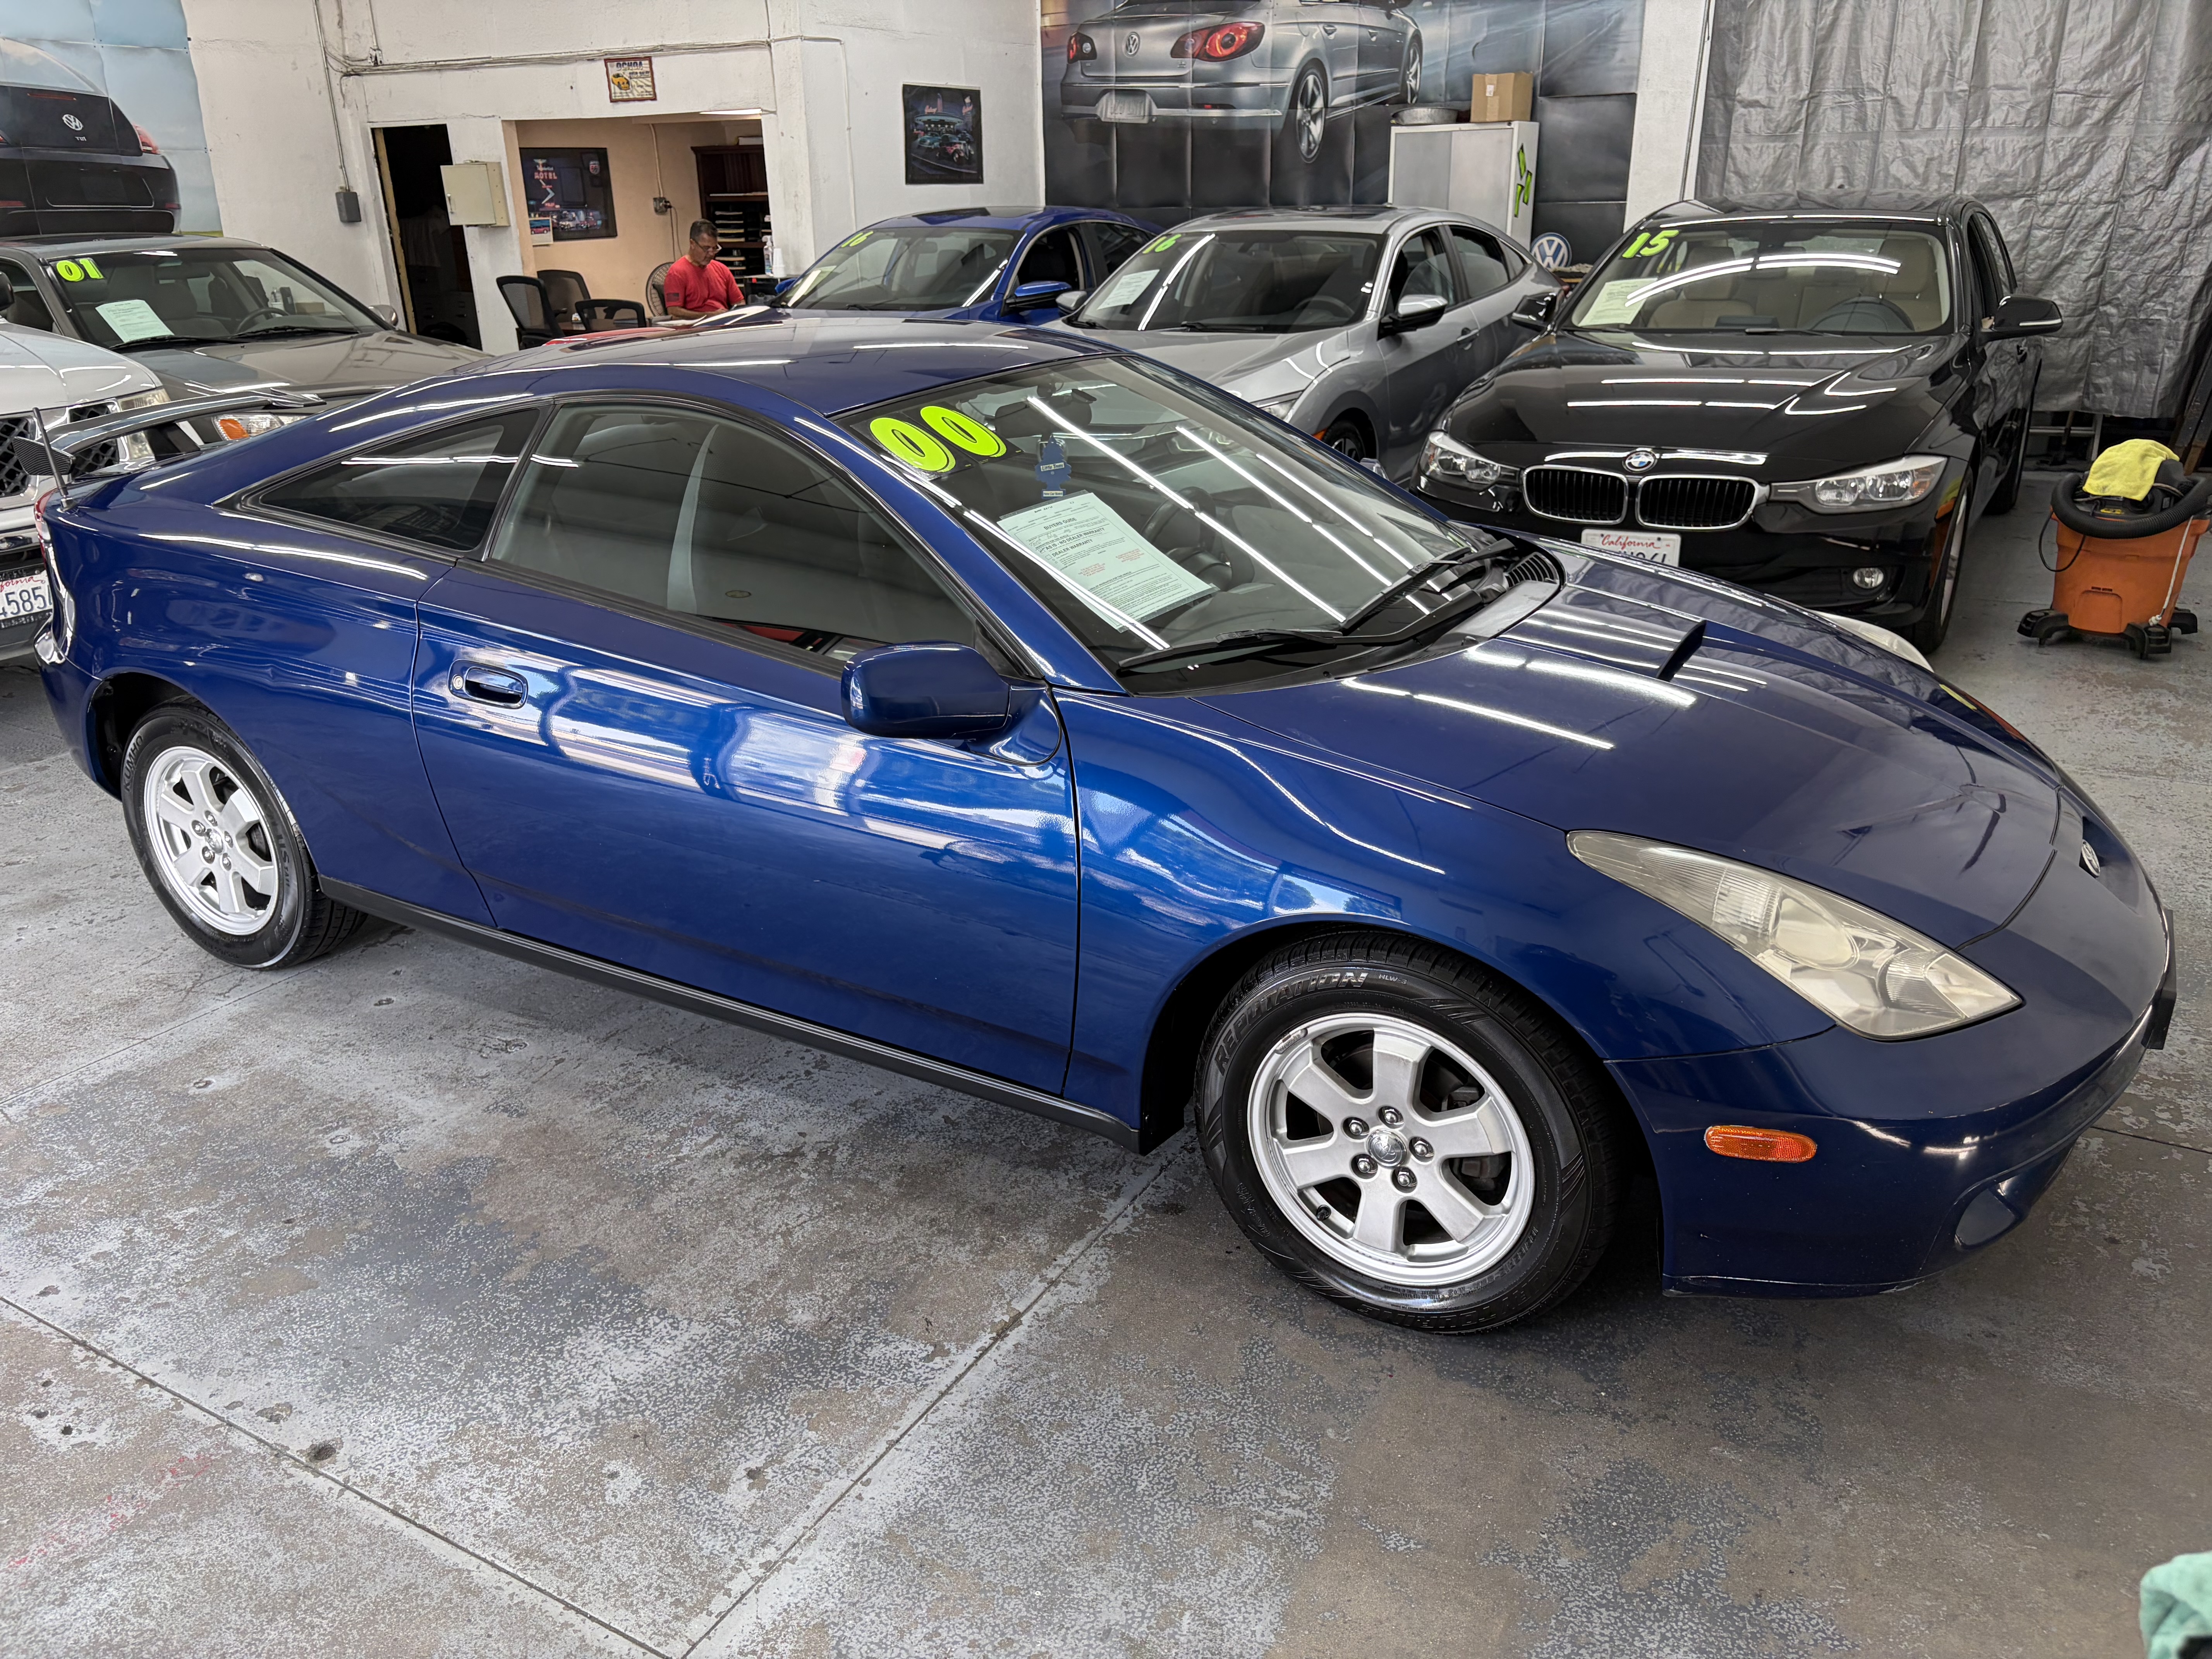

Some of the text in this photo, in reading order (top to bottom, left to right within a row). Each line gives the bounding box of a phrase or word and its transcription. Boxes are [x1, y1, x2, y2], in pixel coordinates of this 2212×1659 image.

[841, 231, 873, 247] 16
[1142, 234, 1182, 254] 16
[1622, 230, 1680, 258] 15
[56, 259, 105, 282] 01
[870, 405, 1007, 473] 00
[1043, 520, 1063, 531] BUYERS
[1067, 534, 1084, 543] DEALER
[1084, 527, 1105, 536] WARRANTY
[1052, 538, 1093, 557] DEALER WARRANTY
[1601, 534, 1661, 550] California
[122, 735, 143, 793] KUMHO
[1214, 972, 1369, 1076] REPUTATION
